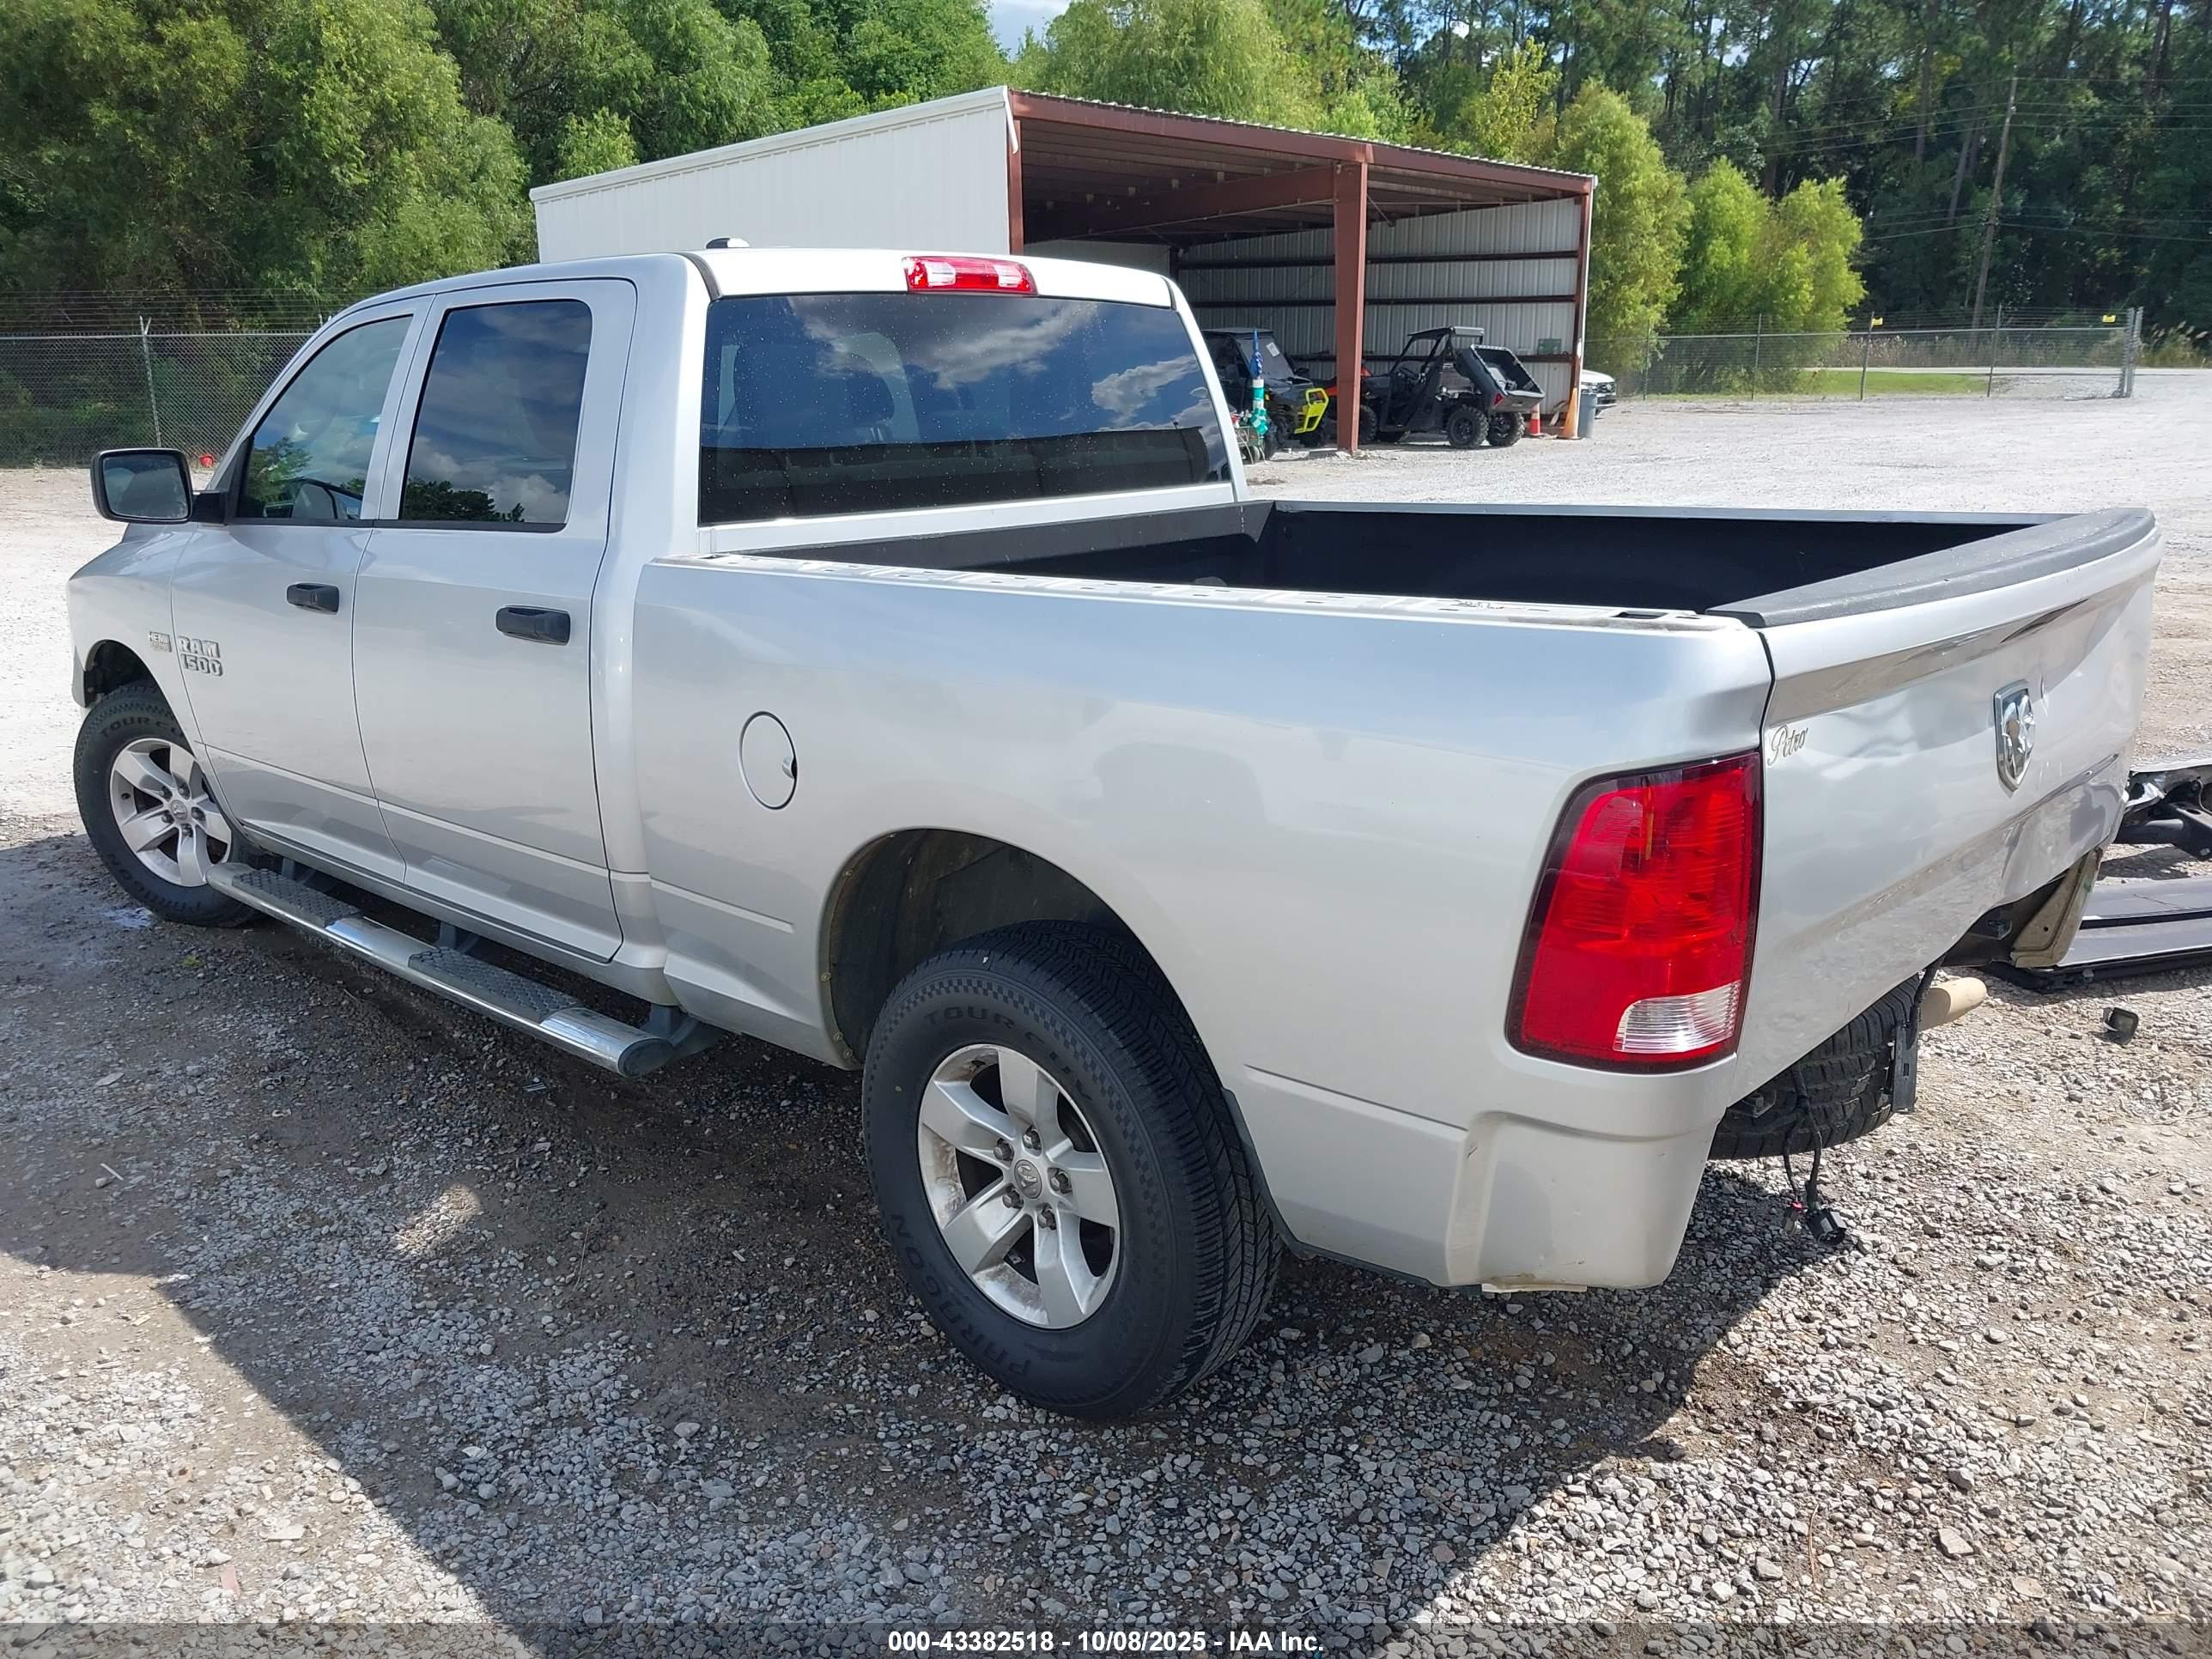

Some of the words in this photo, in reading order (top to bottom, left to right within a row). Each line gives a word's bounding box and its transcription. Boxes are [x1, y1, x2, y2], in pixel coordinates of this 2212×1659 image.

[177, 635, 221, 659] RAM
[180, 653, 223, 677] 1500
[924, 1006, 1016, 1030] TOUR
[883, 1212, 1031, 1376] PARAGON
